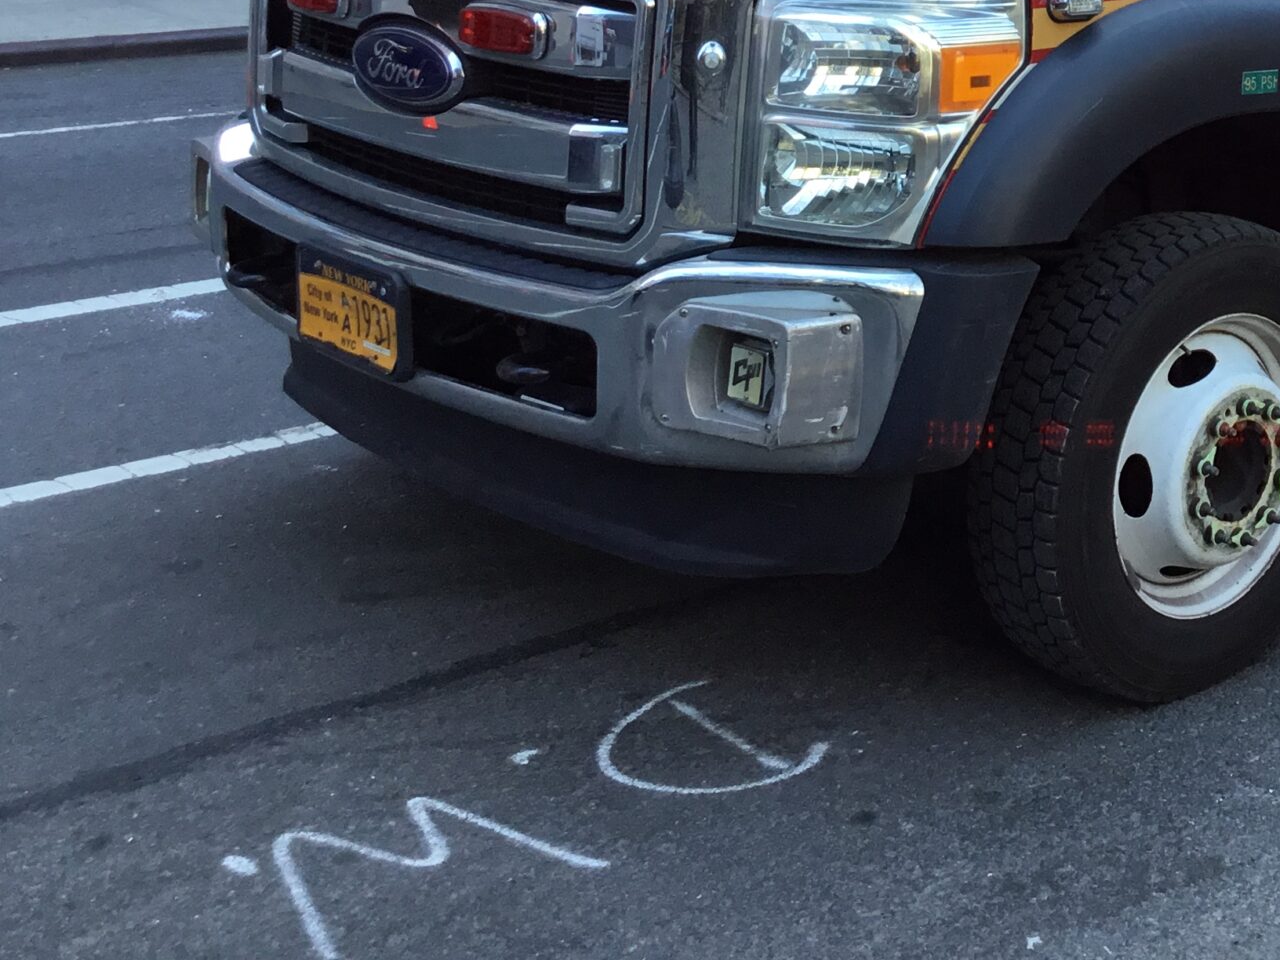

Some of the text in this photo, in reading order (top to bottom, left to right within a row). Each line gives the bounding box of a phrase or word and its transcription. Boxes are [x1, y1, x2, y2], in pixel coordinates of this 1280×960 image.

[367, 38, 424, 89] Ford
[321, 263, 371, 293] NEW YORK
[322, 305, 339, 325] York
[340, 337, 357, 351] NYC
